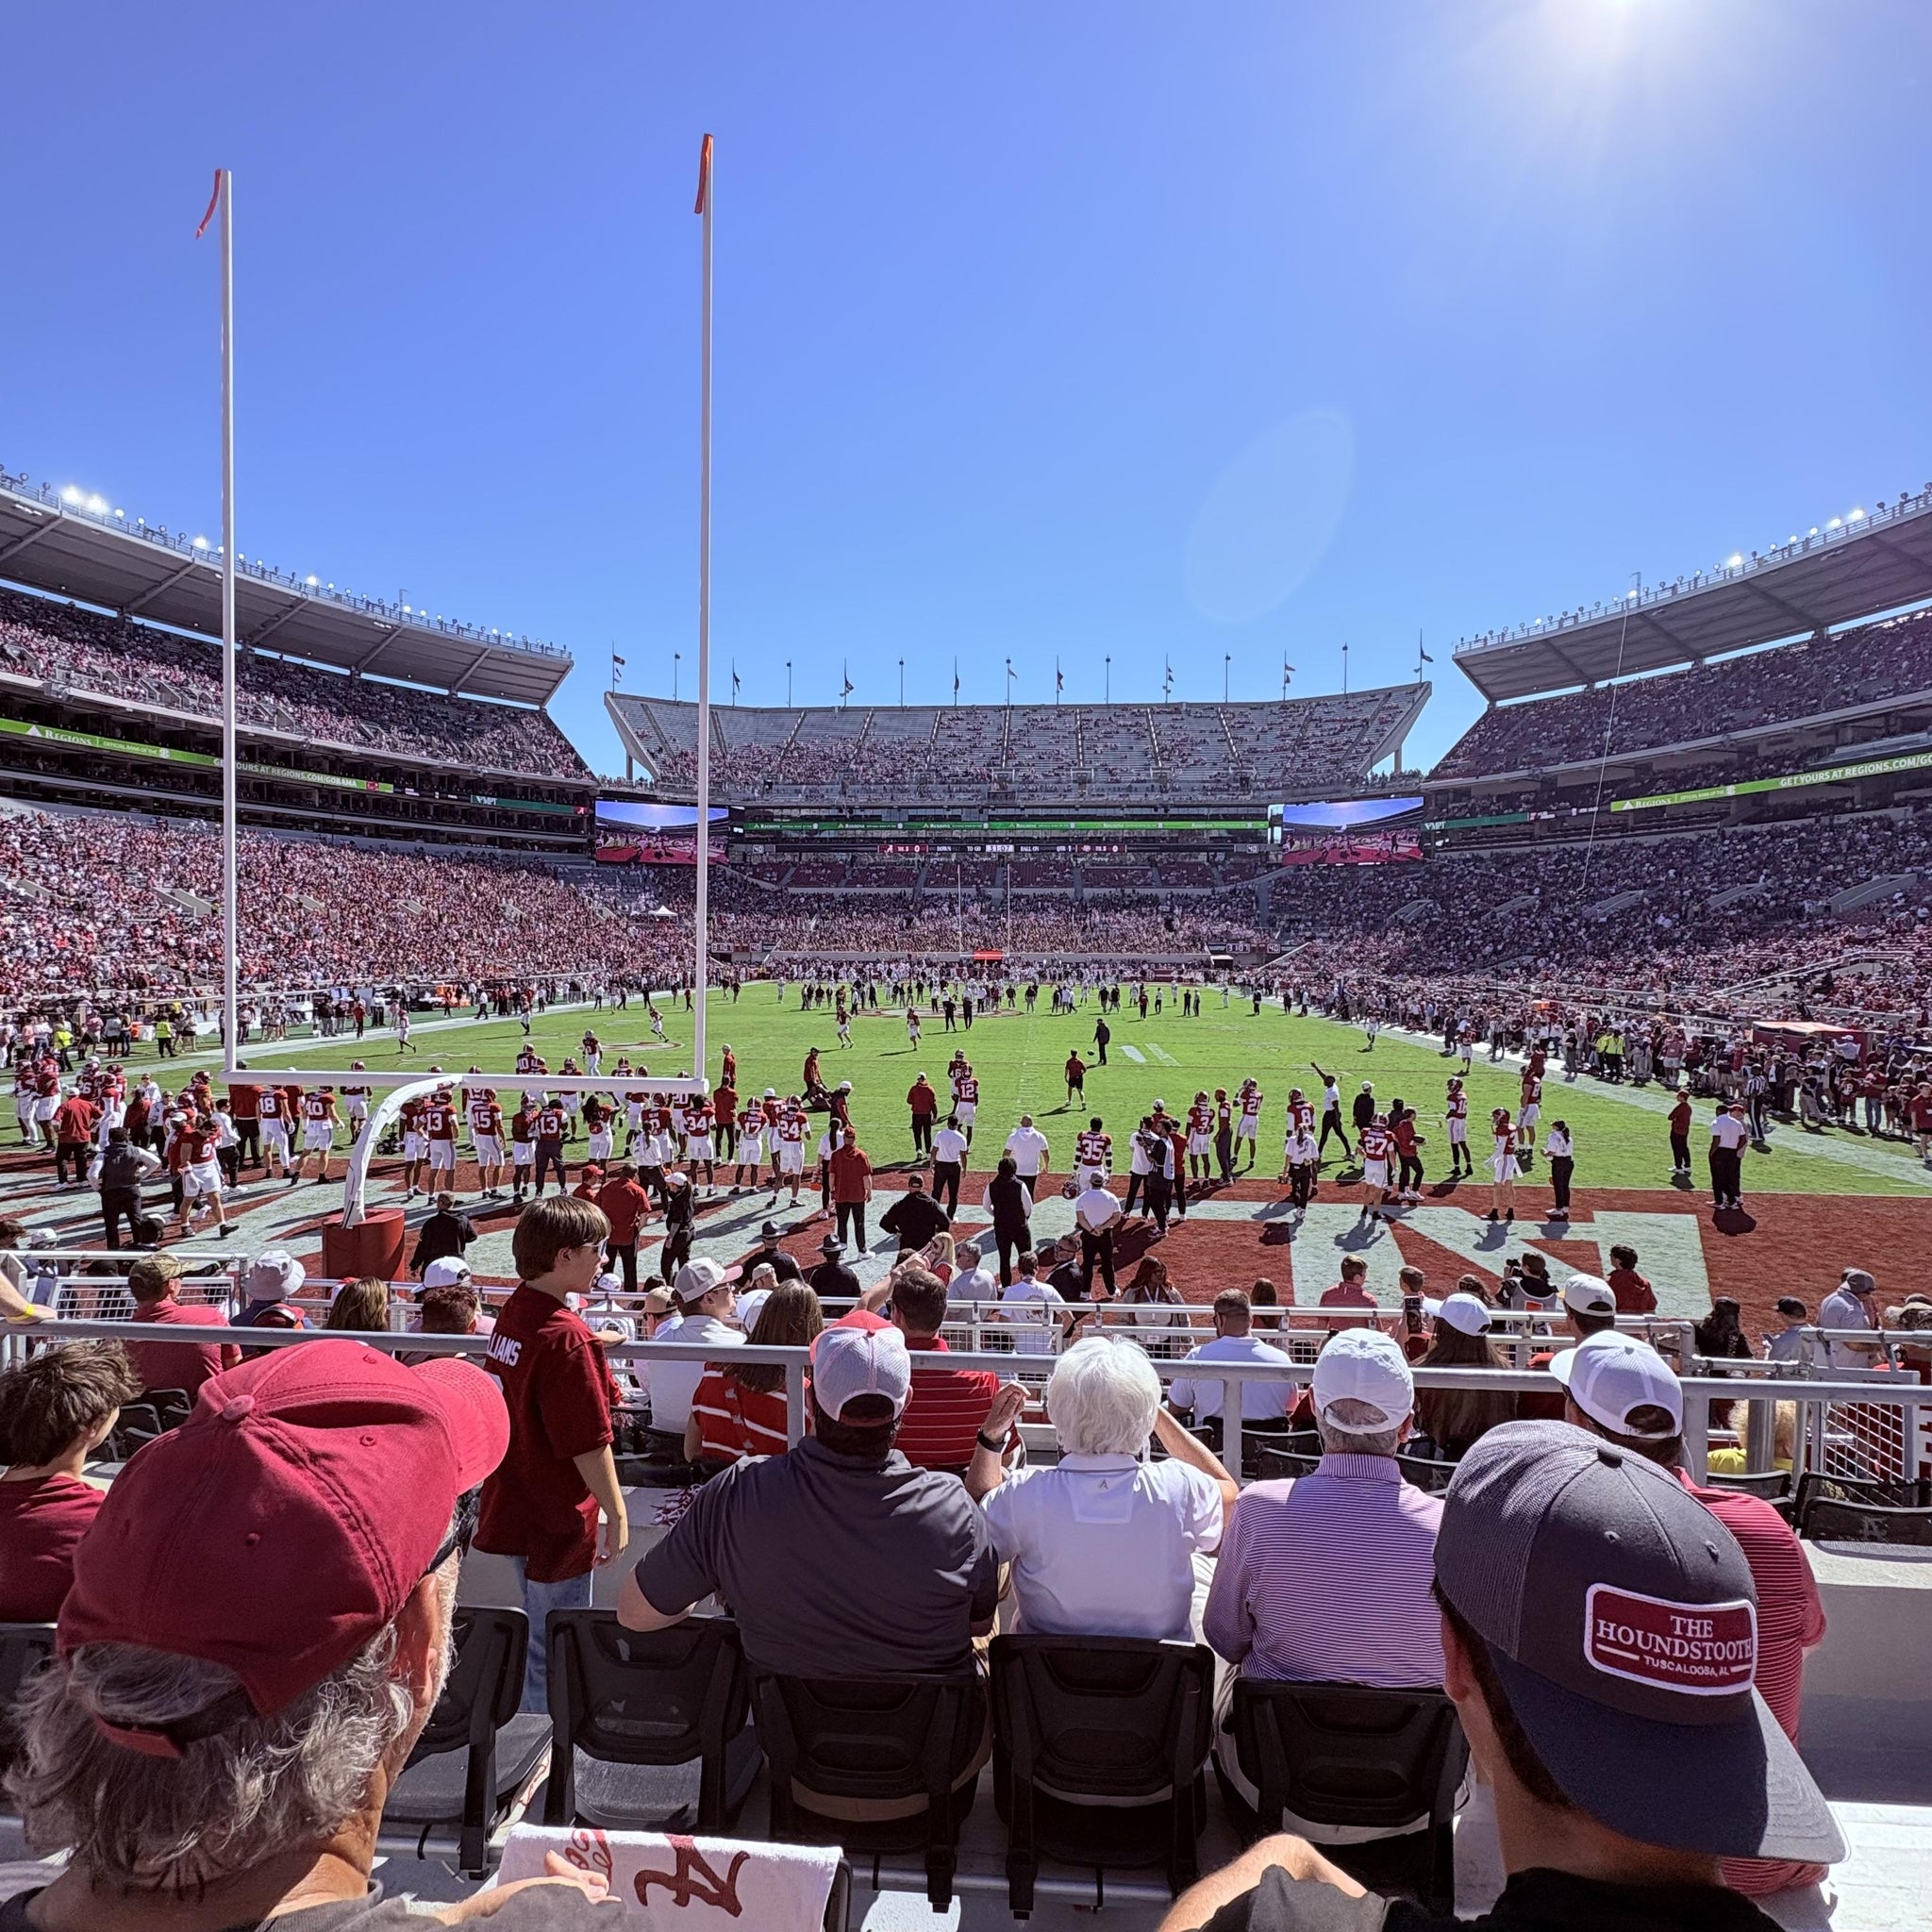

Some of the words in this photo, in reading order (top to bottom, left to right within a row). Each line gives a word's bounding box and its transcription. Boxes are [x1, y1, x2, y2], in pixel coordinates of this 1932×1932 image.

[45, 730, 92, 746] REGIONS
[236, 762, 258, 774] OURS
[1780, 777, 1798, 788] GET
[1799, 772, 1830, 784] YOURS
[1831, 769, 1844, 779] AT
[1635, 796, 1672, 809] REGIONS
[960, 1085, 974, 1098] 12
[259, 1097, 276, 1113] 18
[426, 1112, 442, 1131] 13
[539, 1116, 558, 1134] 13
[686, 1116, 708, 1131] 34
[744, 1122, 761, 1134] 17
[780, 1120, 800, 1139] 24
[201, 1142, 213, 1158] 9
[1081, 1140, 1105, 1160] 35
[1364, 1136, 1389, 1156] 27
[1670, 1614, 1713, 1639] THE
[1642, 1654, 1718, 1677] TUSCALOOSA,
[1718, 1665, 1729, 1676] AL
